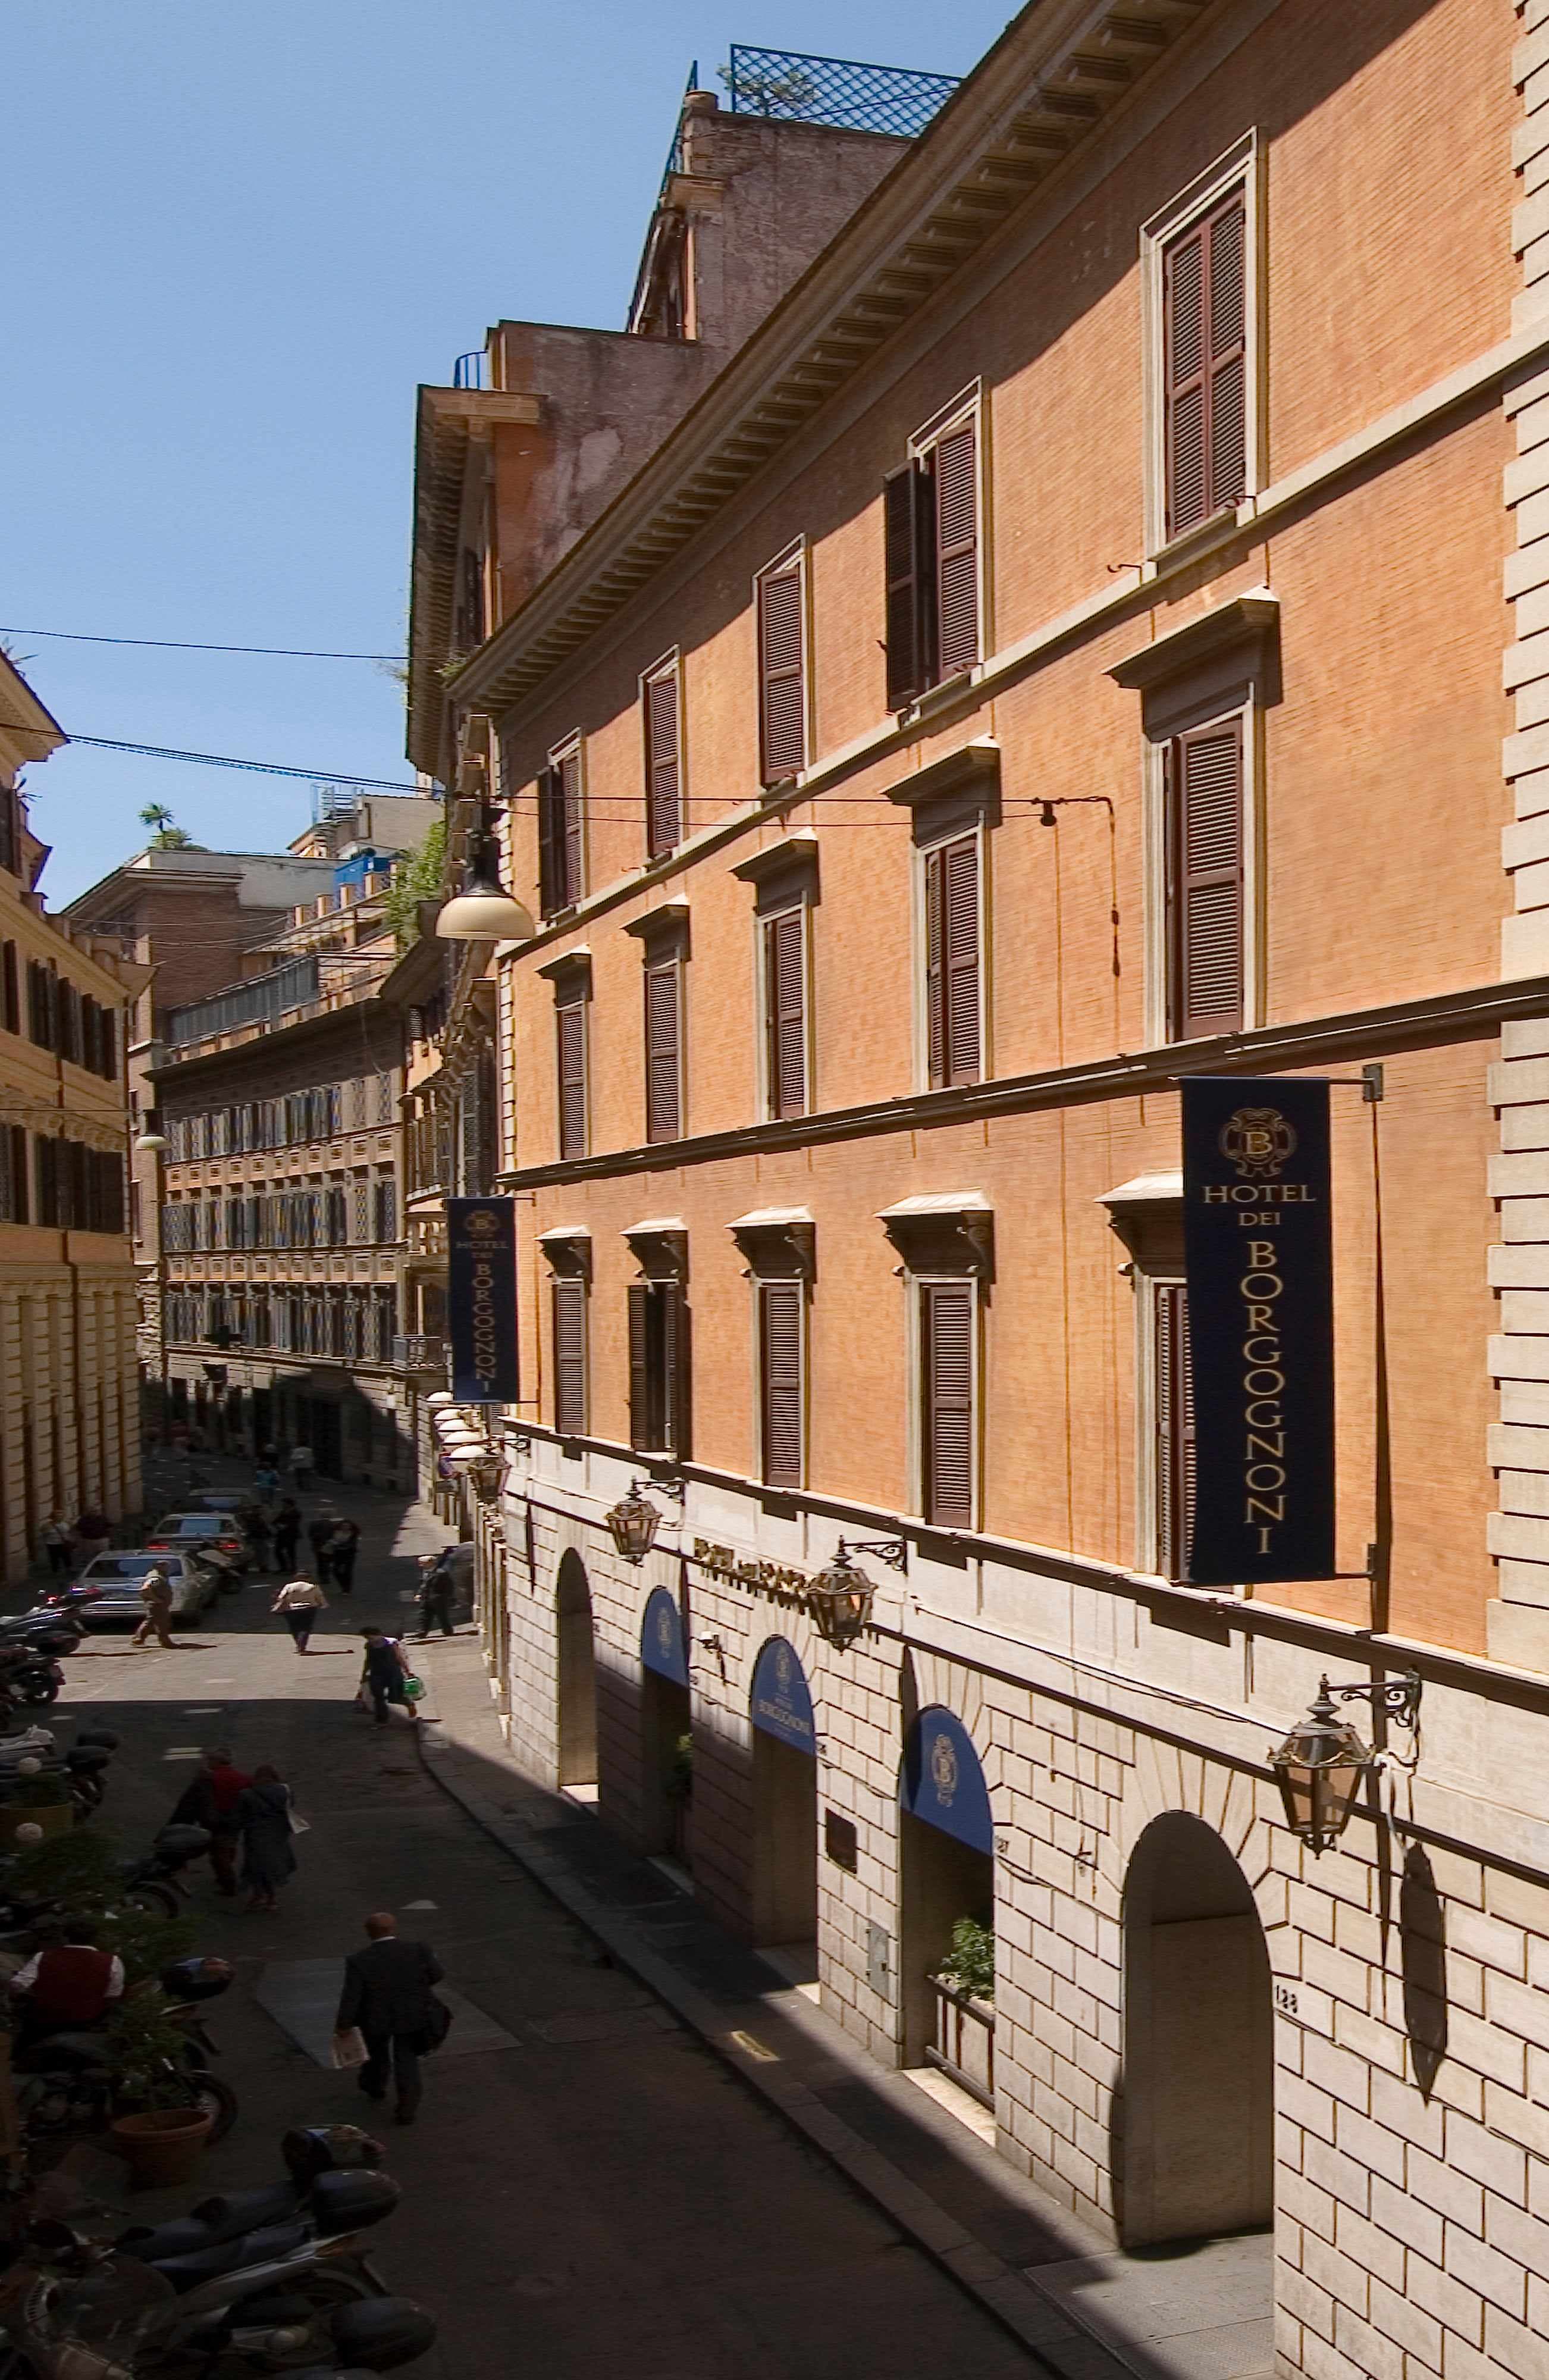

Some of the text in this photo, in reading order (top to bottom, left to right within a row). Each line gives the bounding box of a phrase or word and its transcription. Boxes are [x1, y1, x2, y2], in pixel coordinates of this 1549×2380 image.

[1242, 1131, 1274, 1155] B
[1202, 1184, 1317, 1204] HOTEL
[1238, 1211, 1281, 1226] DEI
[471, 1264, 496, 1393] BORGOGNONI
[1240, 1241, 1288, 1554] BORGOGNONI
